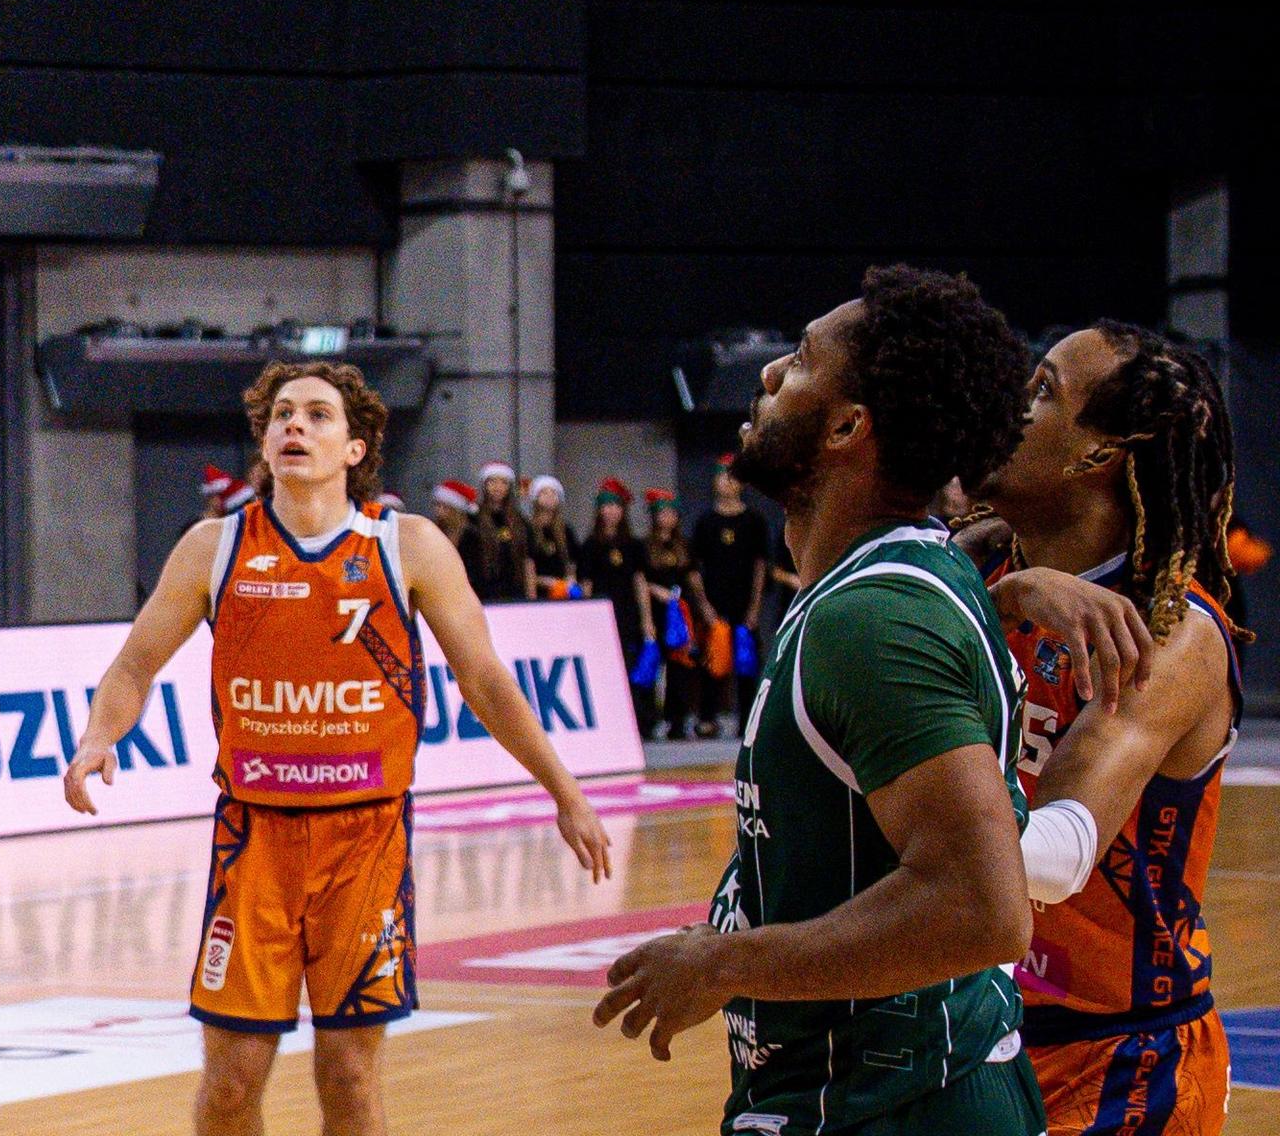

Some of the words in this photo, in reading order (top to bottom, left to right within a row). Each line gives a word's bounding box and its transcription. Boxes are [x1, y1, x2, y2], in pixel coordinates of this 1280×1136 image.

[336, 598, 371, 646] 7
[229, 676, 386, 715] GLIWICE
[320, 720, 349, 738] jest
[274, 761, 369, 785] TAURON
